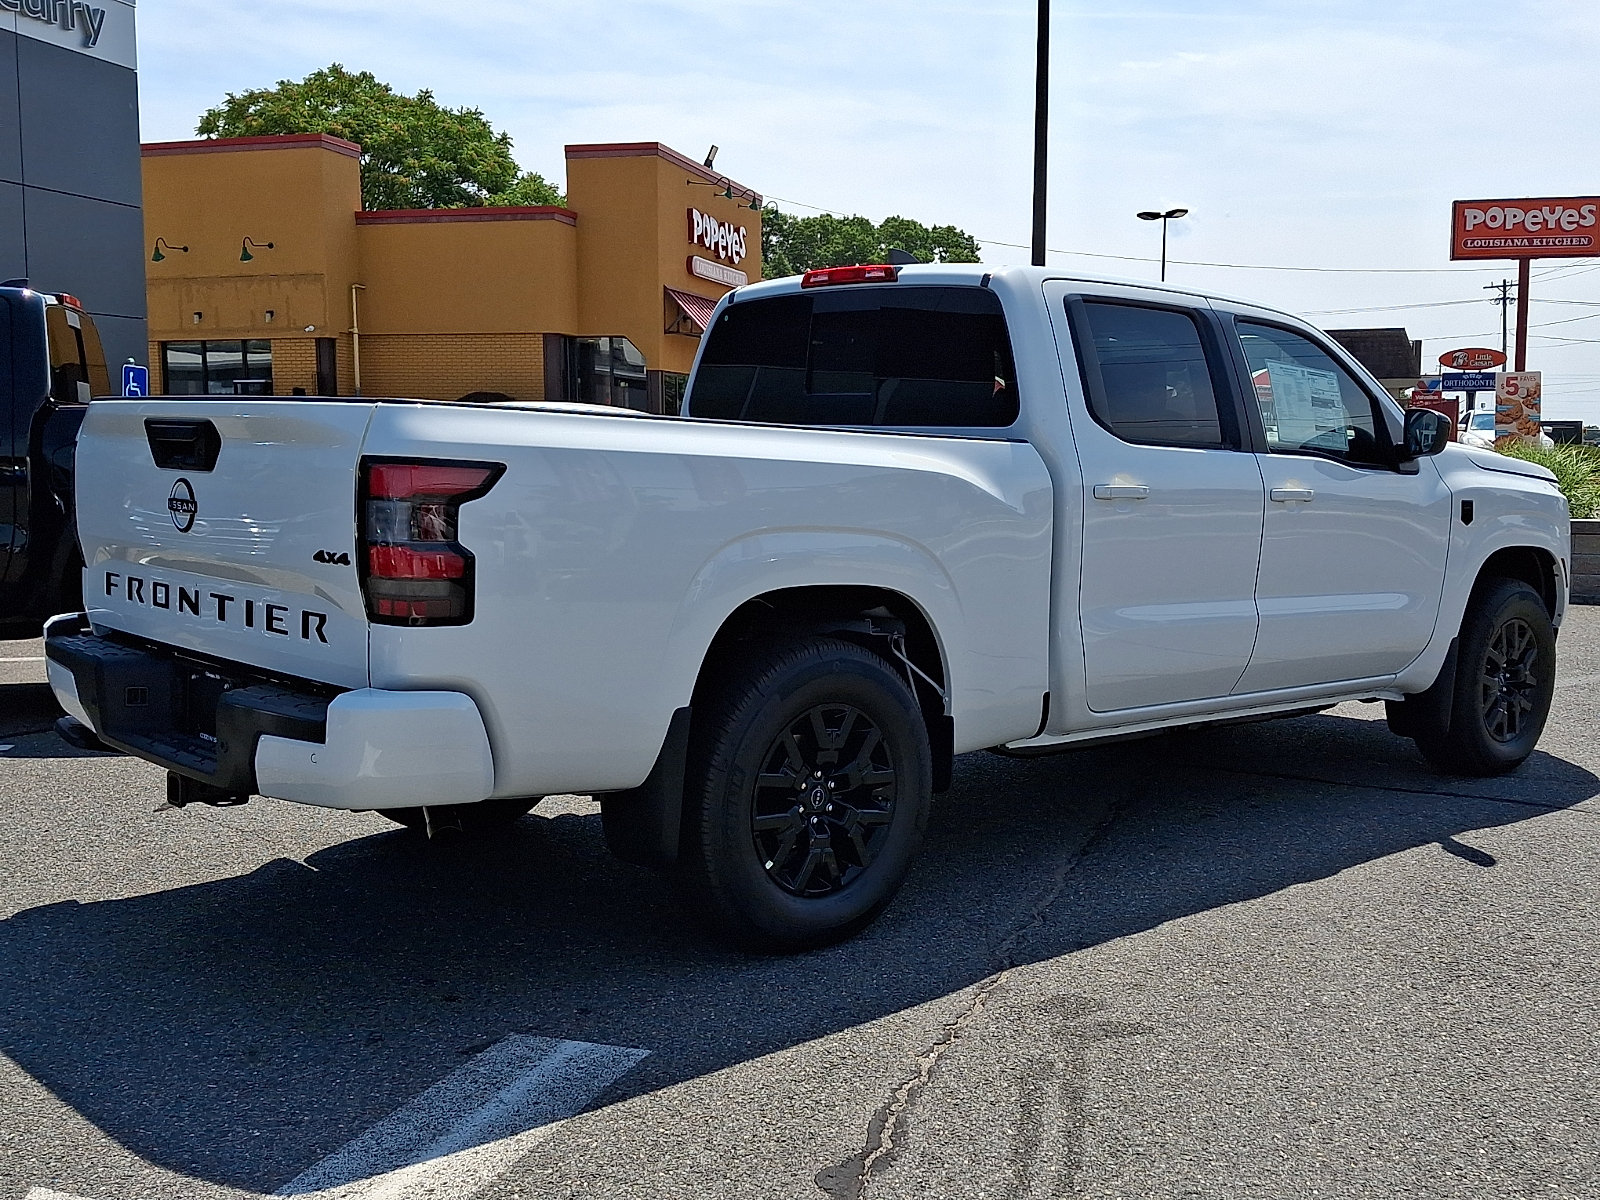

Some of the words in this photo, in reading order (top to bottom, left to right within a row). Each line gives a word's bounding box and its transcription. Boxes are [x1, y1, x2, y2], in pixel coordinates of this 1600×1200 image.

[1466, 238, 1529, 248] LOUISIANA
[1533, 237, 1589, 246] KITCHEN
[1475, 353, 1493, 361] Little
[105, 571, 330, 644] FRONTIER
